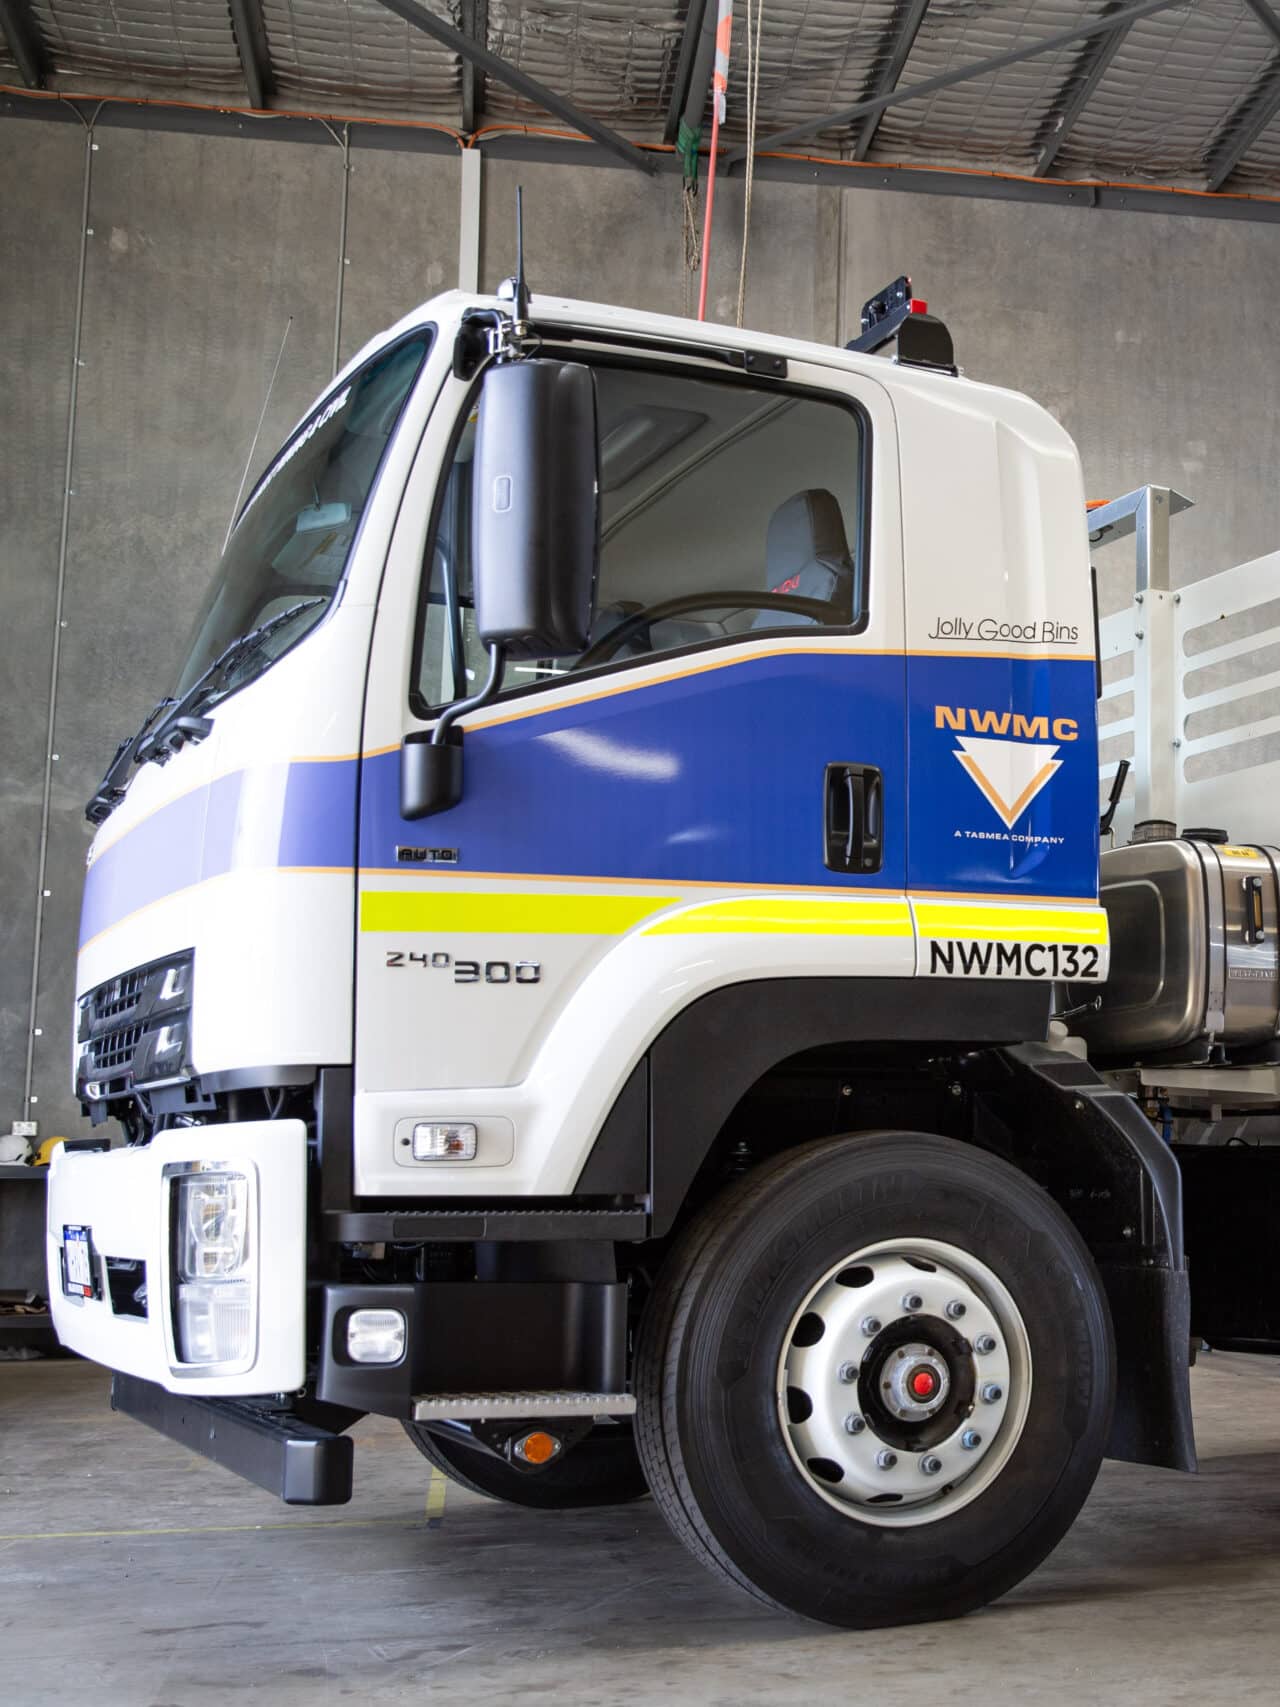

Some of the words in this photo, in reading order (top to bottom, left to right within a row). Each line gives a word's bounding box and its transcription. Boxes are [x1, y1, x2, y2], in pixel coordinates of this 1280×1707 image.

[928, 617, 974, 640] Jolly
[978, 618, 1036, 641] Good
[1042, 621, 1078, 643] Bins
[935, 705, 1078, 741] NWMC
[954, 830, 962, 838] A
[964, 831, 1009, 841] TASMEA
[1011, 834, 1065, 844] COMPANY
[386, 951, 450, 968] 240
[454, 960, 541, 984] 300
[930, 940, 1099, 978] NWMC132
